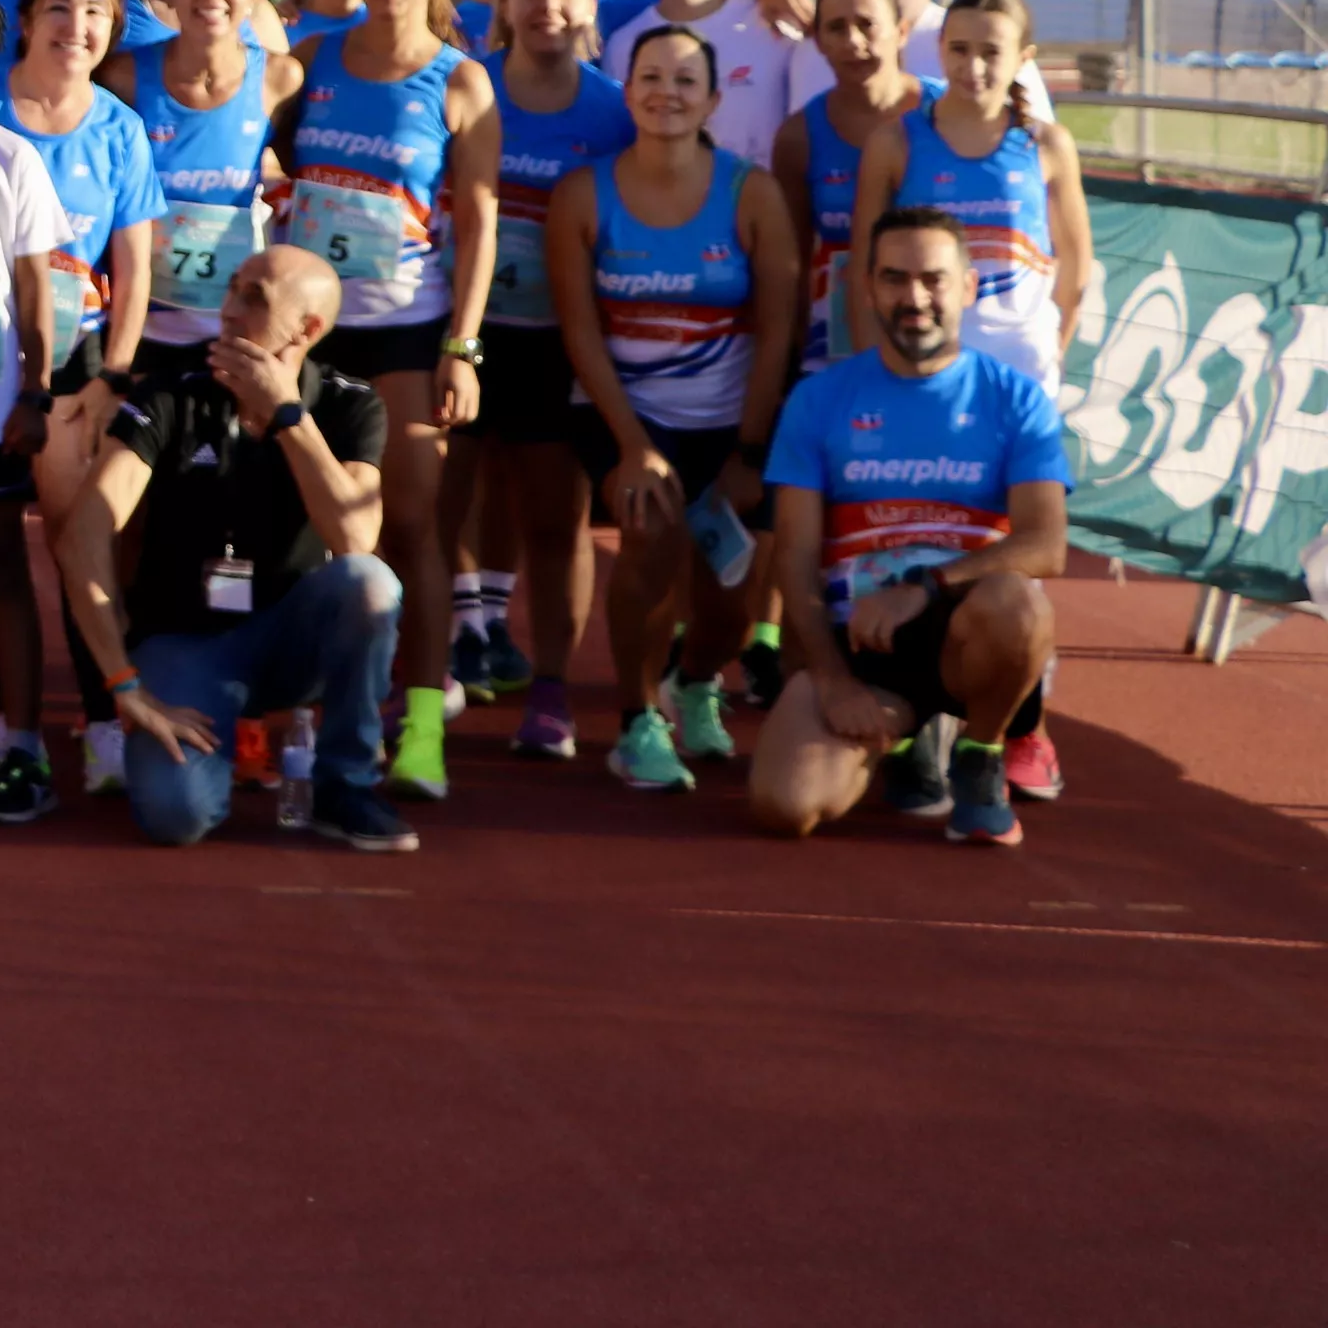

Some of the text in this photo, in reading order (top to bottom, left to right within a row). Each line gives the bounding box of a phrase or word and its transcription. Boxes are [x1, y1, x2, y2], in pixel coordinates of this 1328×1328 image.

[327, 233, 350, 262] 5
[173, 248, 217, 280] 73
[843, 454, 984, 488] enerplus
